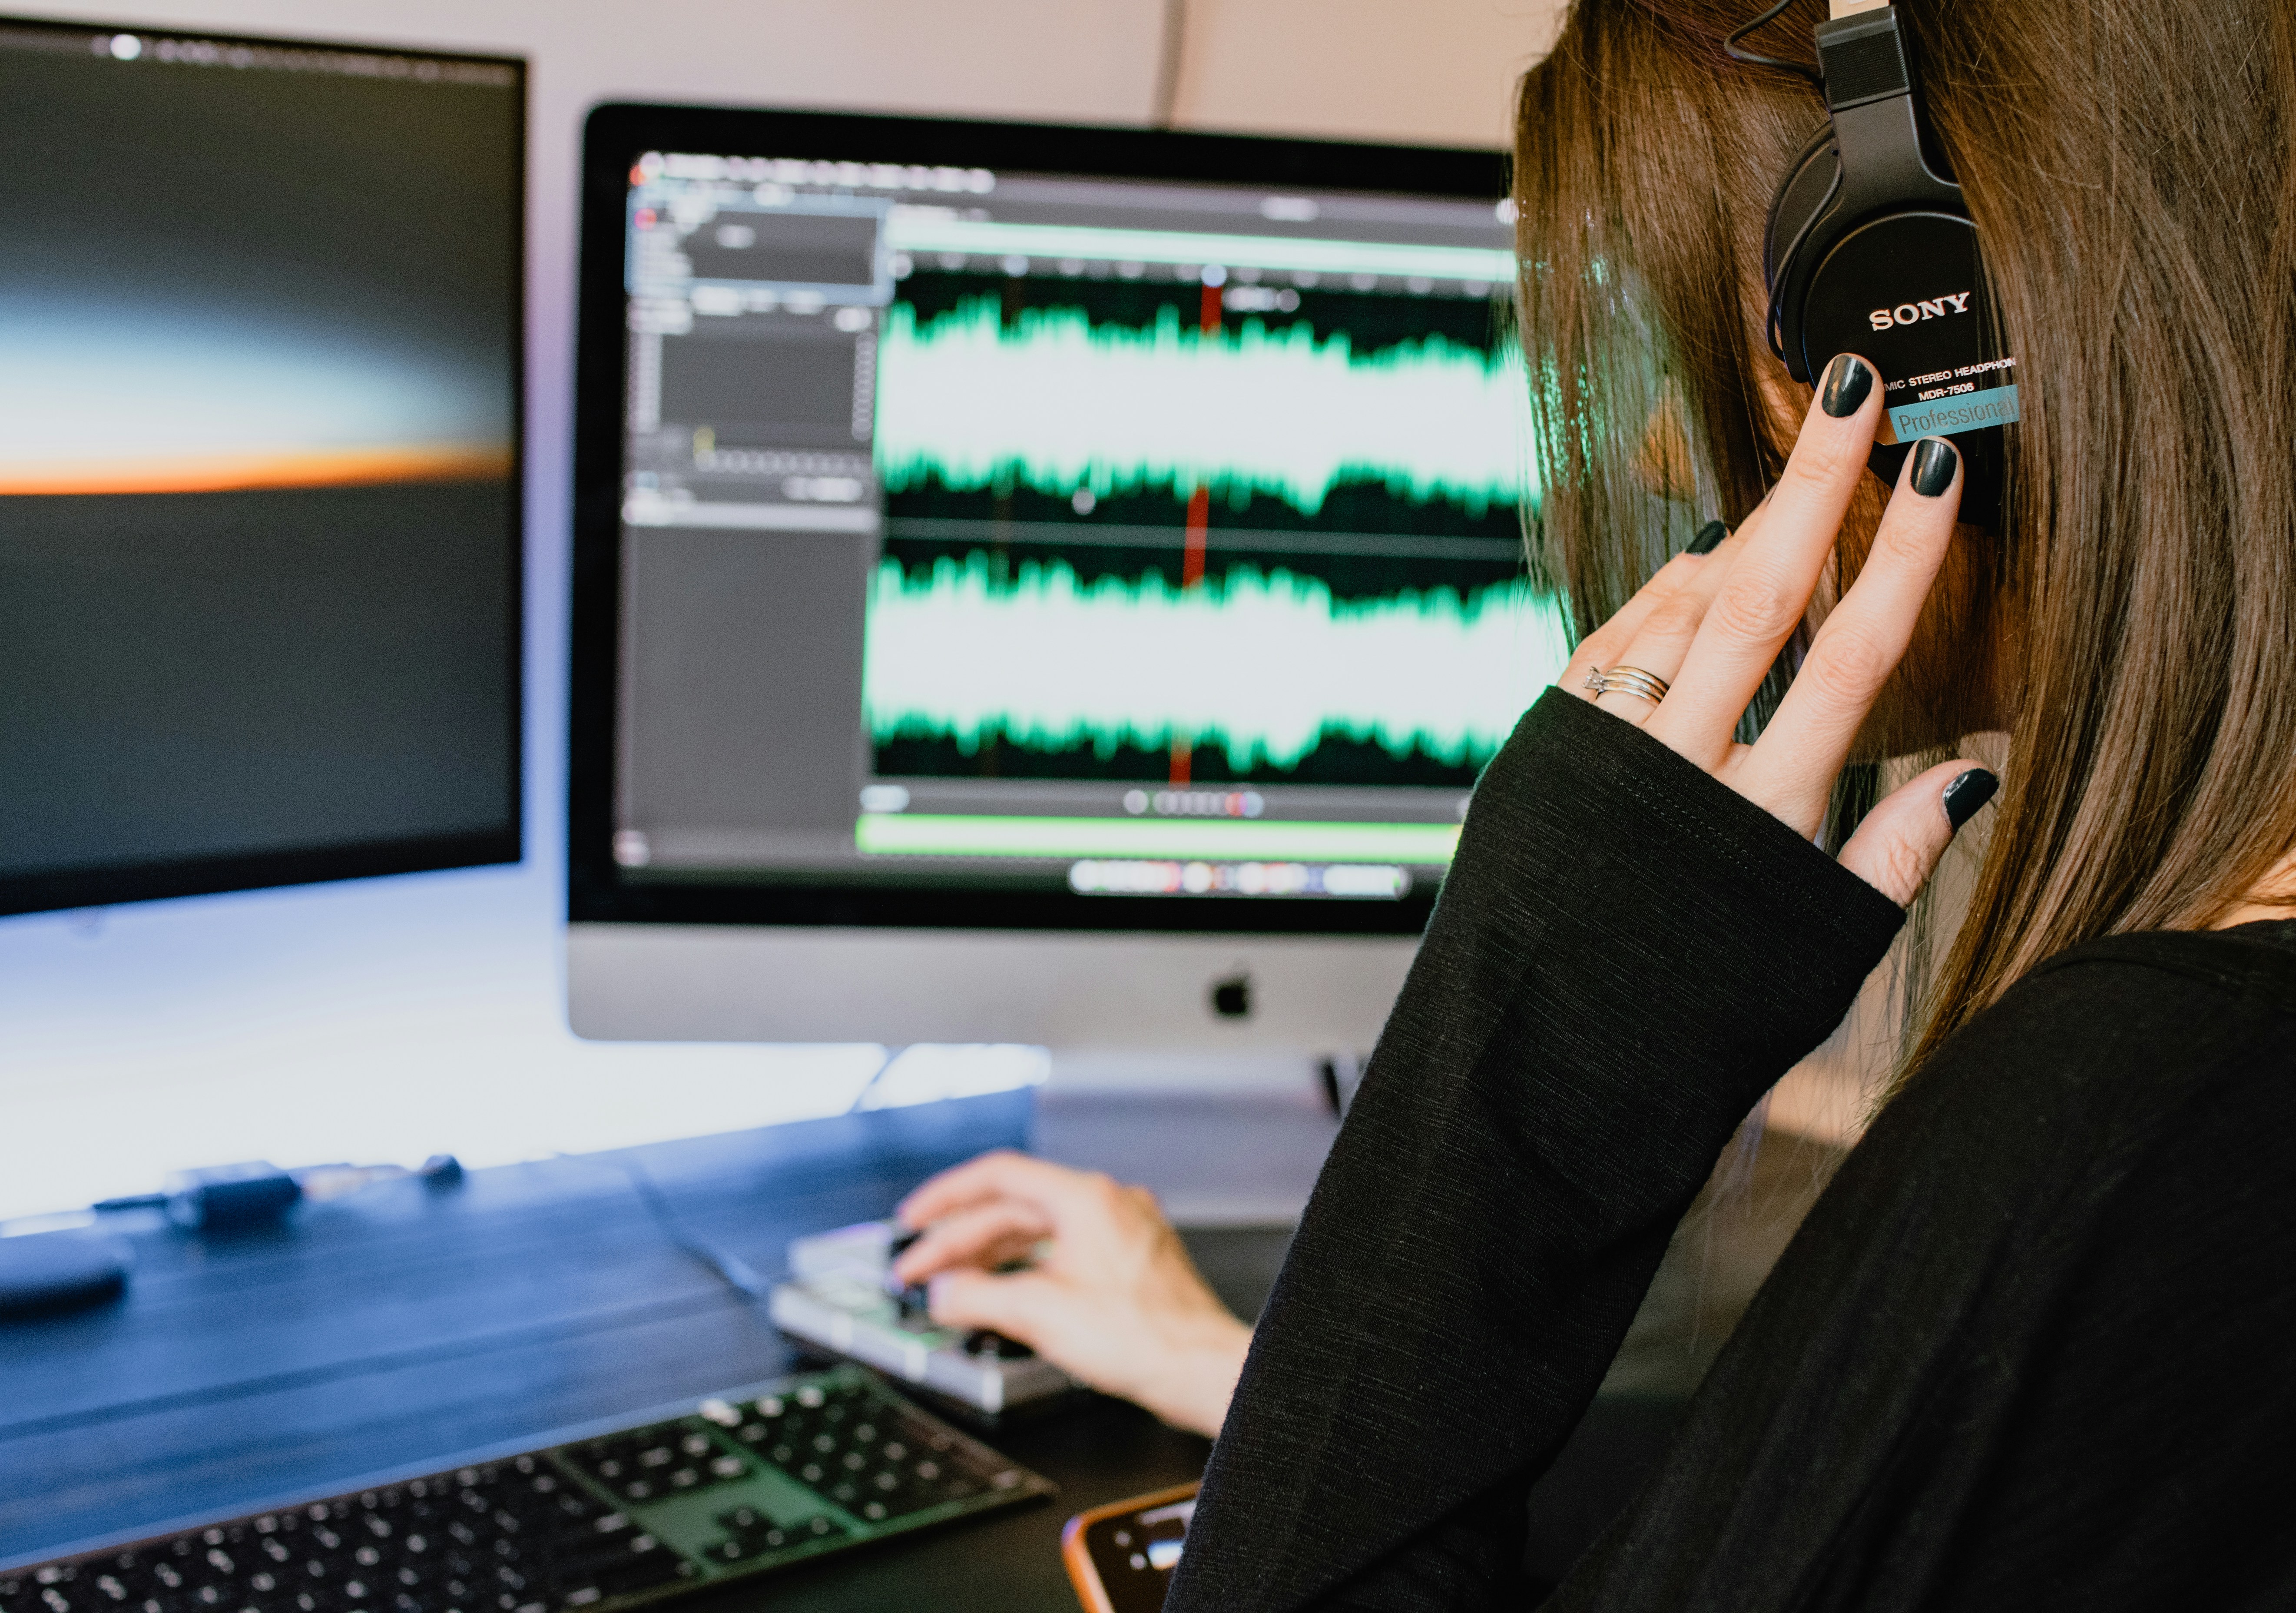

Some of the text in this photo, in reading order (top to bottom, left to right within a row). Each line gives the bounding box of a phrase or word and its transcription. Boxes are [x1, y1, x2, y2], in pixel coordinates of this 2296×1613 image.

[1869, 292, 1970, 331] SONY
[1884, 357, 2016, 391] MIC STEREO HEADPHON
[1918, 382, 1974, 401] MDR-7506
[1898, 396, 2014, 434] Professional
